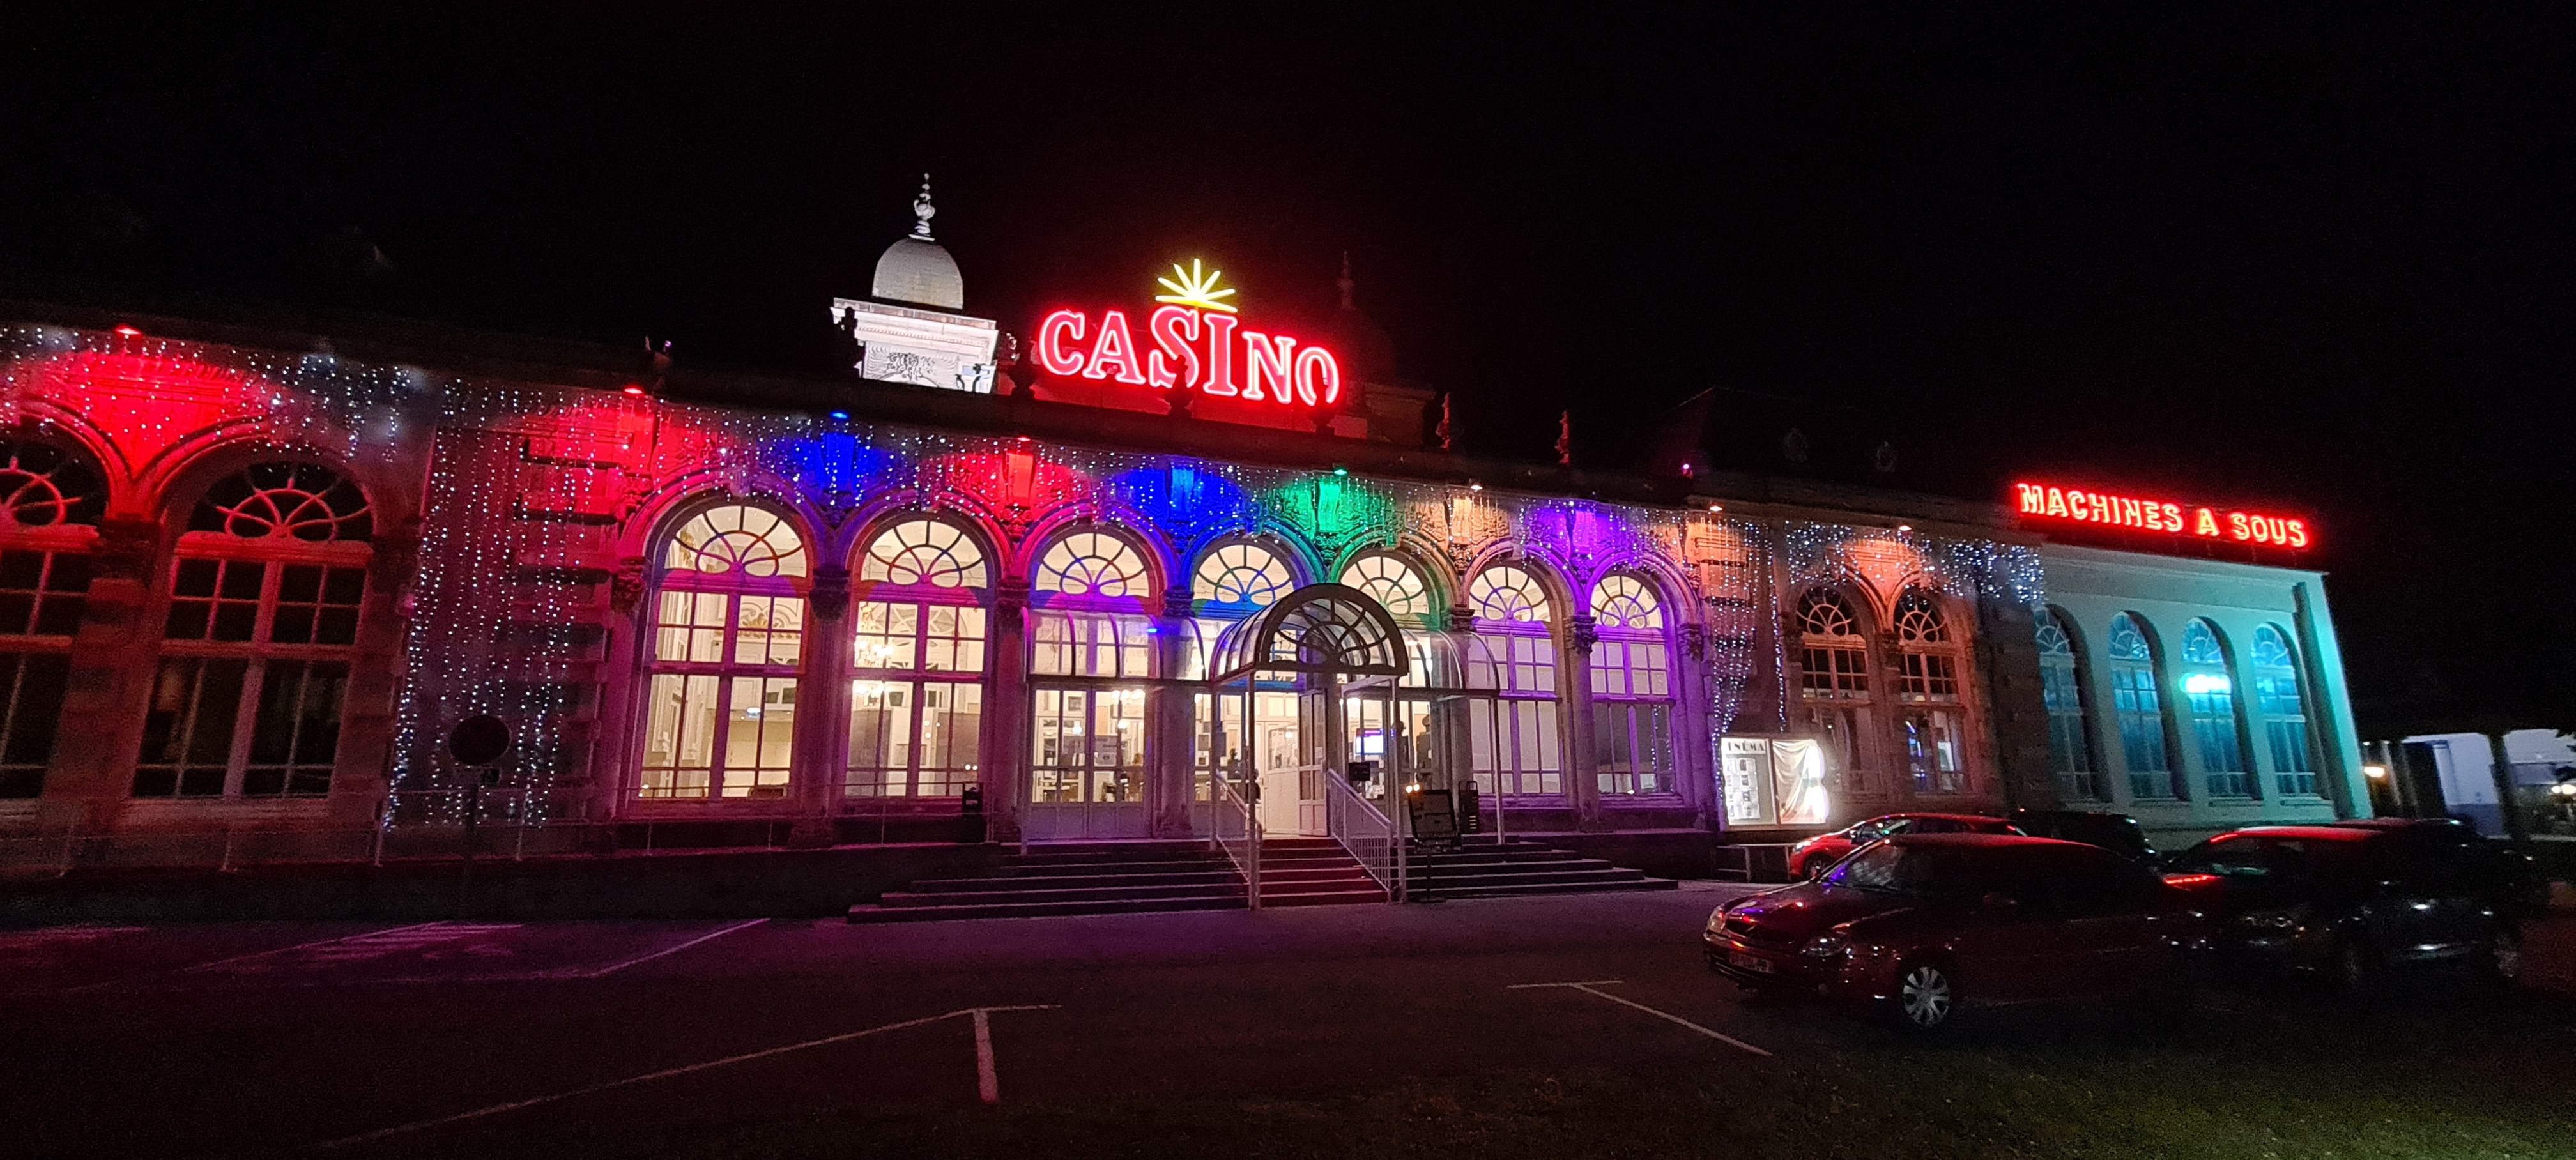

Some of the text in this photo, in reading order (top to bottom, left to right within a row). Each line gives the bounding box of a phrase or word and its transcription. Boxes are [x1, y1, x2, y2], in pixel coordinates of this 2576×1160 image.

[1039, 306, 1340, 406] CASINO
[2017, 483, 2308, 548] MACHINES A SOUS
